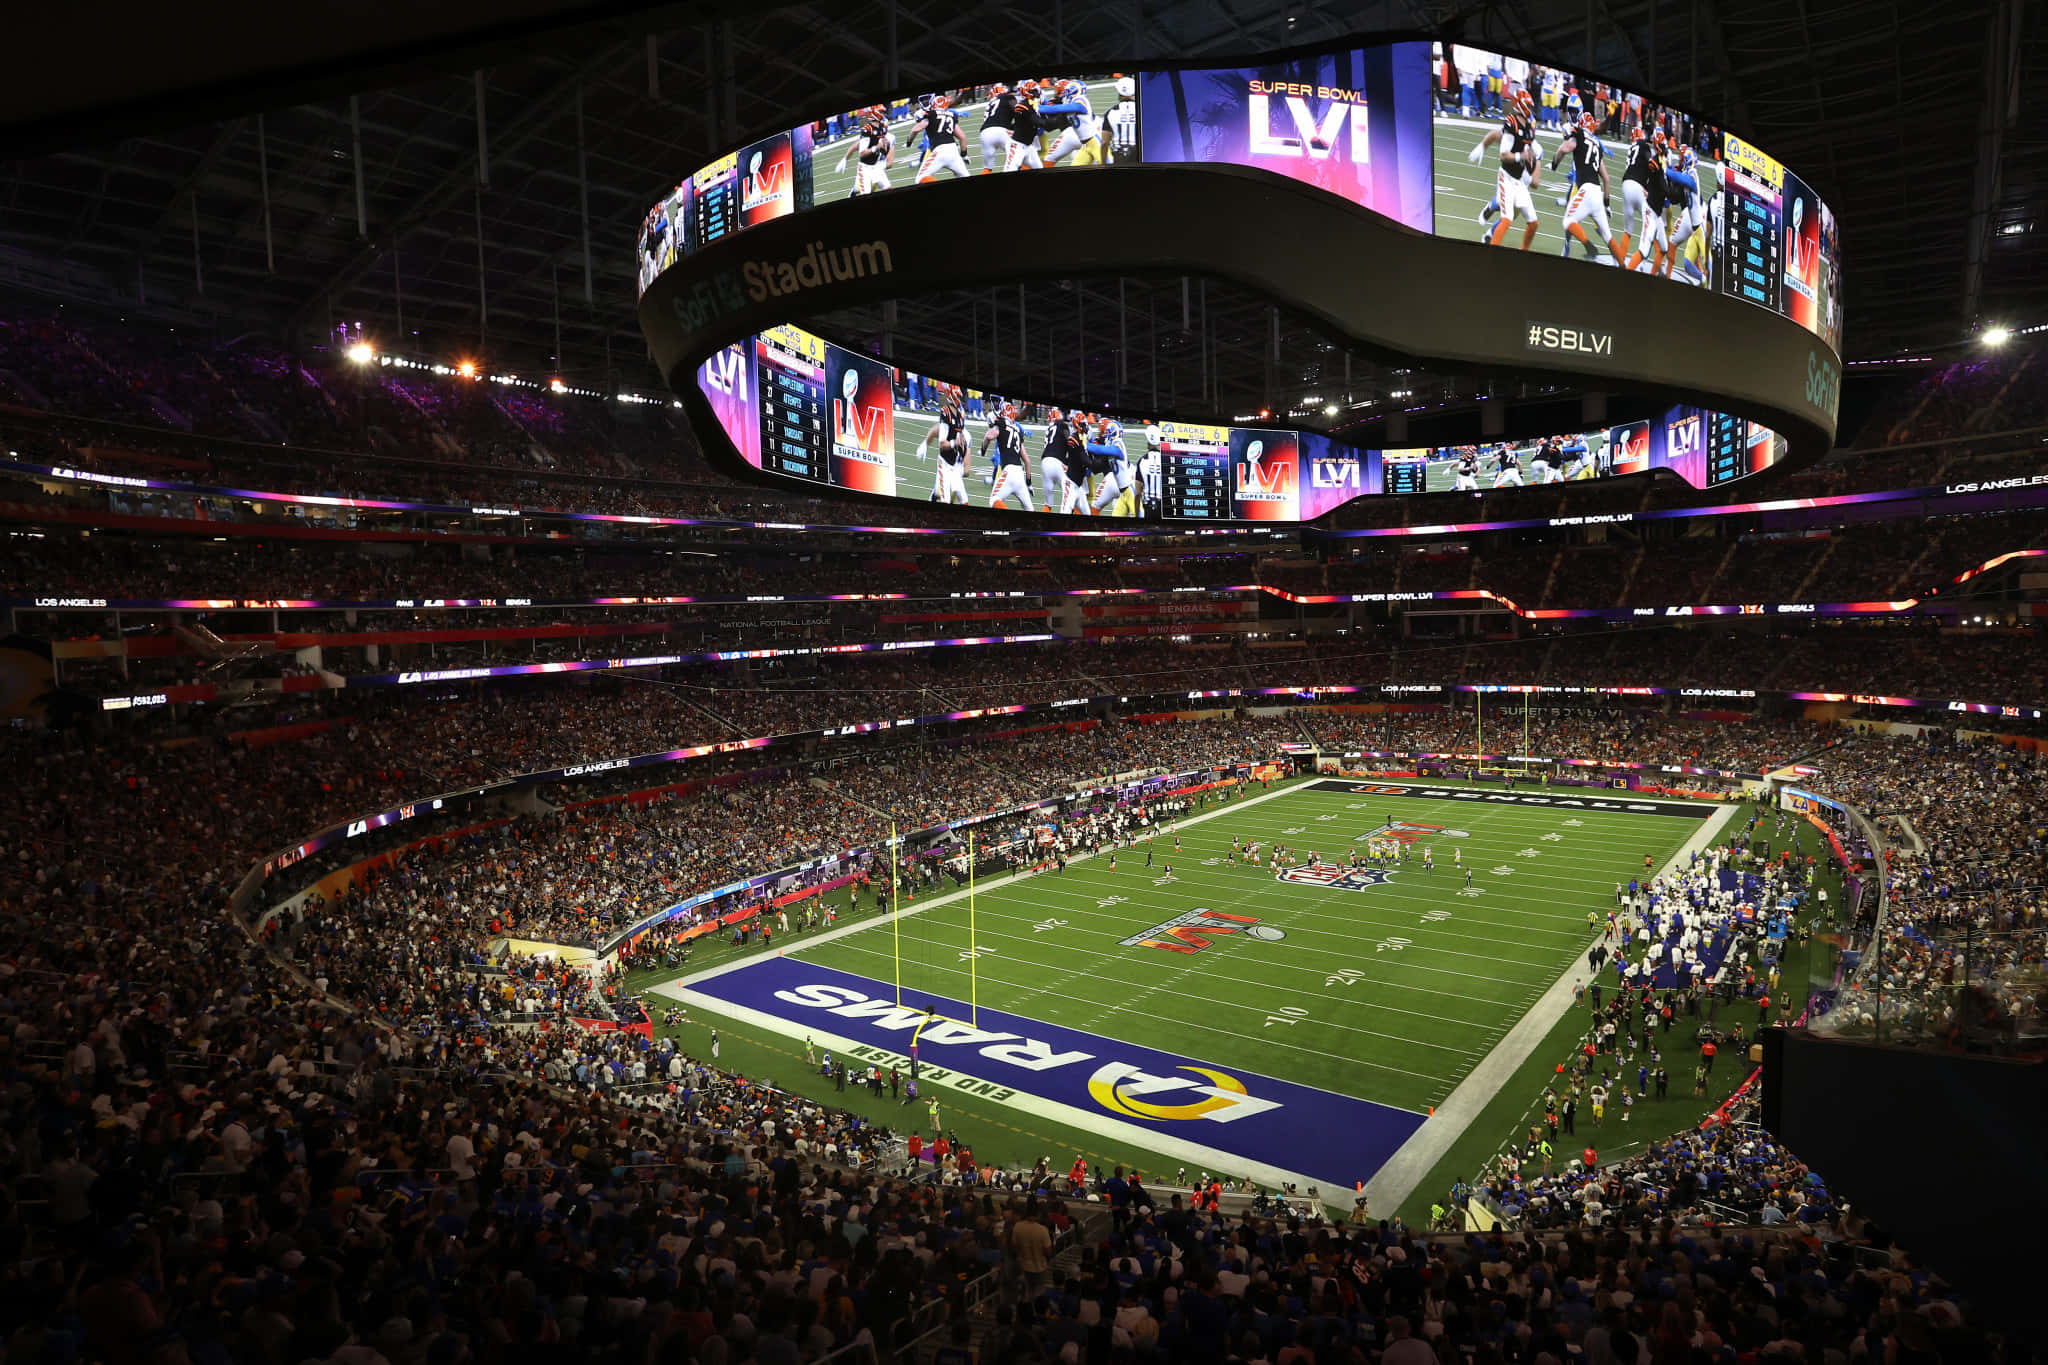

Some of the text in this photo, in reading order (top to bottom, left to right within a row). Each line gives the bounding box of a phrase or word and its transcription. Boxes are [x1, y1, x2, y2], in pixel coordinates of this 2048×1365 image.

[1249, 80, 1368, 104] SUPER BOWL
[936, 113, 954, 133] 73
[1249, 94, 1369, 164] LVI
[1585, 139, 1599, 171] 73
[1743, 147, 1766, 168] SACKS
[743, 161, 787, 202] LVI
[674, 240, 893, 333] SoFi Stadium
[809, 338, 816, 355] 6
[1529, 325, 1613, 355] #SBLVI
[706, 350, 748, 401] LVI
[1806, 352, 1831, 410] SoFi
[833, 398, 889, 455] LVI
[1178, 425, 1205, 434] SACKS
[1005, 427, 1020, 453] 73
[1668, 420, 1700, 458] LVI
[838, 446, 884, 465] SUPER BOWL
[77, 471, 90, 481] LOS
[92, 473, 124, 485] ANGELES
[125, 477, 148, 487] RAMS
[814, 466, 819, 478] 2
[1237, 461, 1292, 493] LVI
[1312, 463, 1361, 488] LVI
[1946, 475, 2048, 494] LOS ANGELES
[1549, 513, 1633, 526] SUPER BOWL LVI
[35, 598, 107, 607] LOS ANGELES
[396, 599, 414, 608] RAMS
[504, 598, 531, 606] BENGALS
[1352, 592, 1433, 602] SUPER BOWL LVI
[1160, 602, 1217, 614] BENGALS
[1633, 608, 1654, 616] RAMS
[1778, 604, 1815, 612] BENGALS
[719, 617, 832, 629] NATIONAL FOOTBALL LEAGUE
[398, 668, 491, 684] LA LOS ANGELES RAMS
[1680, 688, 1756, 698] LOS ANGELES
[563, 759, 630, 777] LOS ANGELES
[1420, 791, 1657, 811] BENGALS
[1792, 797, 1809, 812] LA
[1097, 894, 1129, 908] 30
[1455, 887, 1487, 898] 50
[1031, 917, 1069, 933] 20
[1420, 910, 1452, 924] 40
[958, 944, 997, 962] 10
[1376, 936, 1413, 953] 30
[1324, 968, 1367, 988] 20
[1264, 1005, 1310, 1028] 10
[774, 985, 1096, 1072] RAMS
[849, 1045, 1016, 1102] END RACISM
